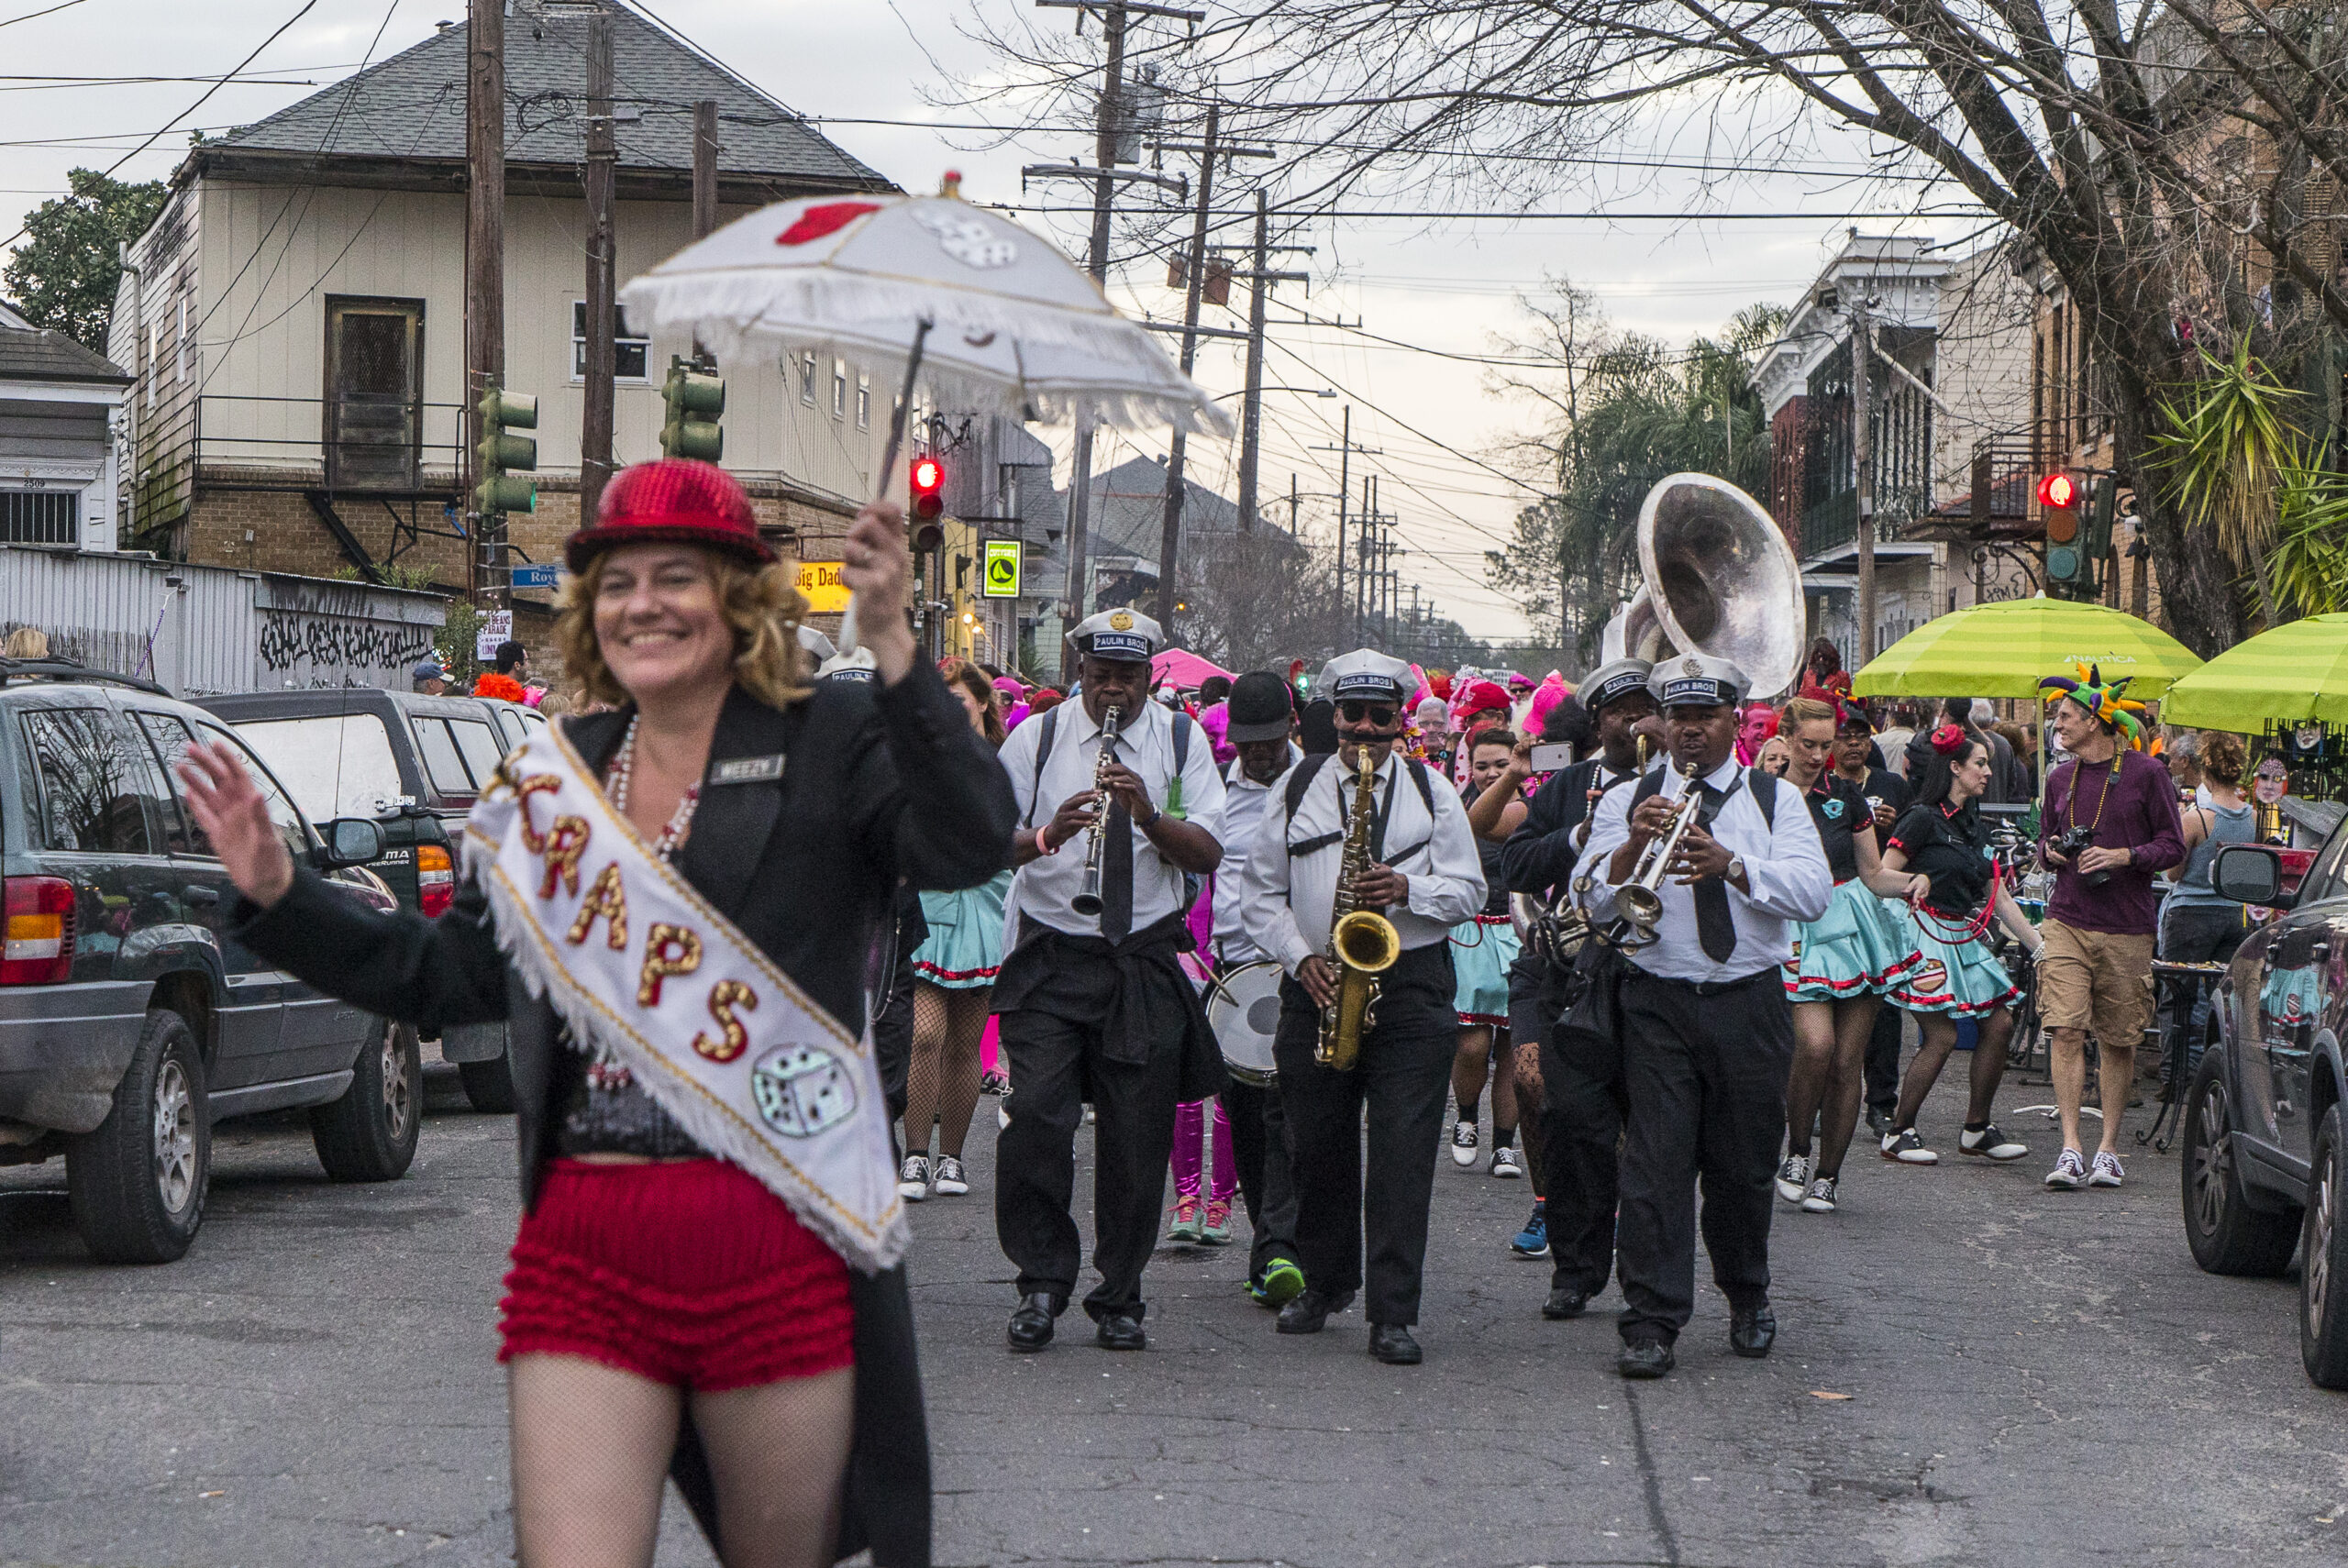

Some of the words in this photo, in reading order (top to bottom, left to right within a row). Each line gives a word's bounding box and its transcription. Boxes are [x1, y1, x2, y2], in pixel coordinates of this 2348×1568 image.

[24, 480, 45, 488] 2509
[531, 571, 557, 585] Roy
[818, 567, 844, 586] Dad
[1095, 636, 1124, 646] PAULIN
[2072, 655, 2136, 663] NAUTICA
[1340, 677, 1366, 686] PAULIN
[516, 774, 759, 1065] CRAPS
